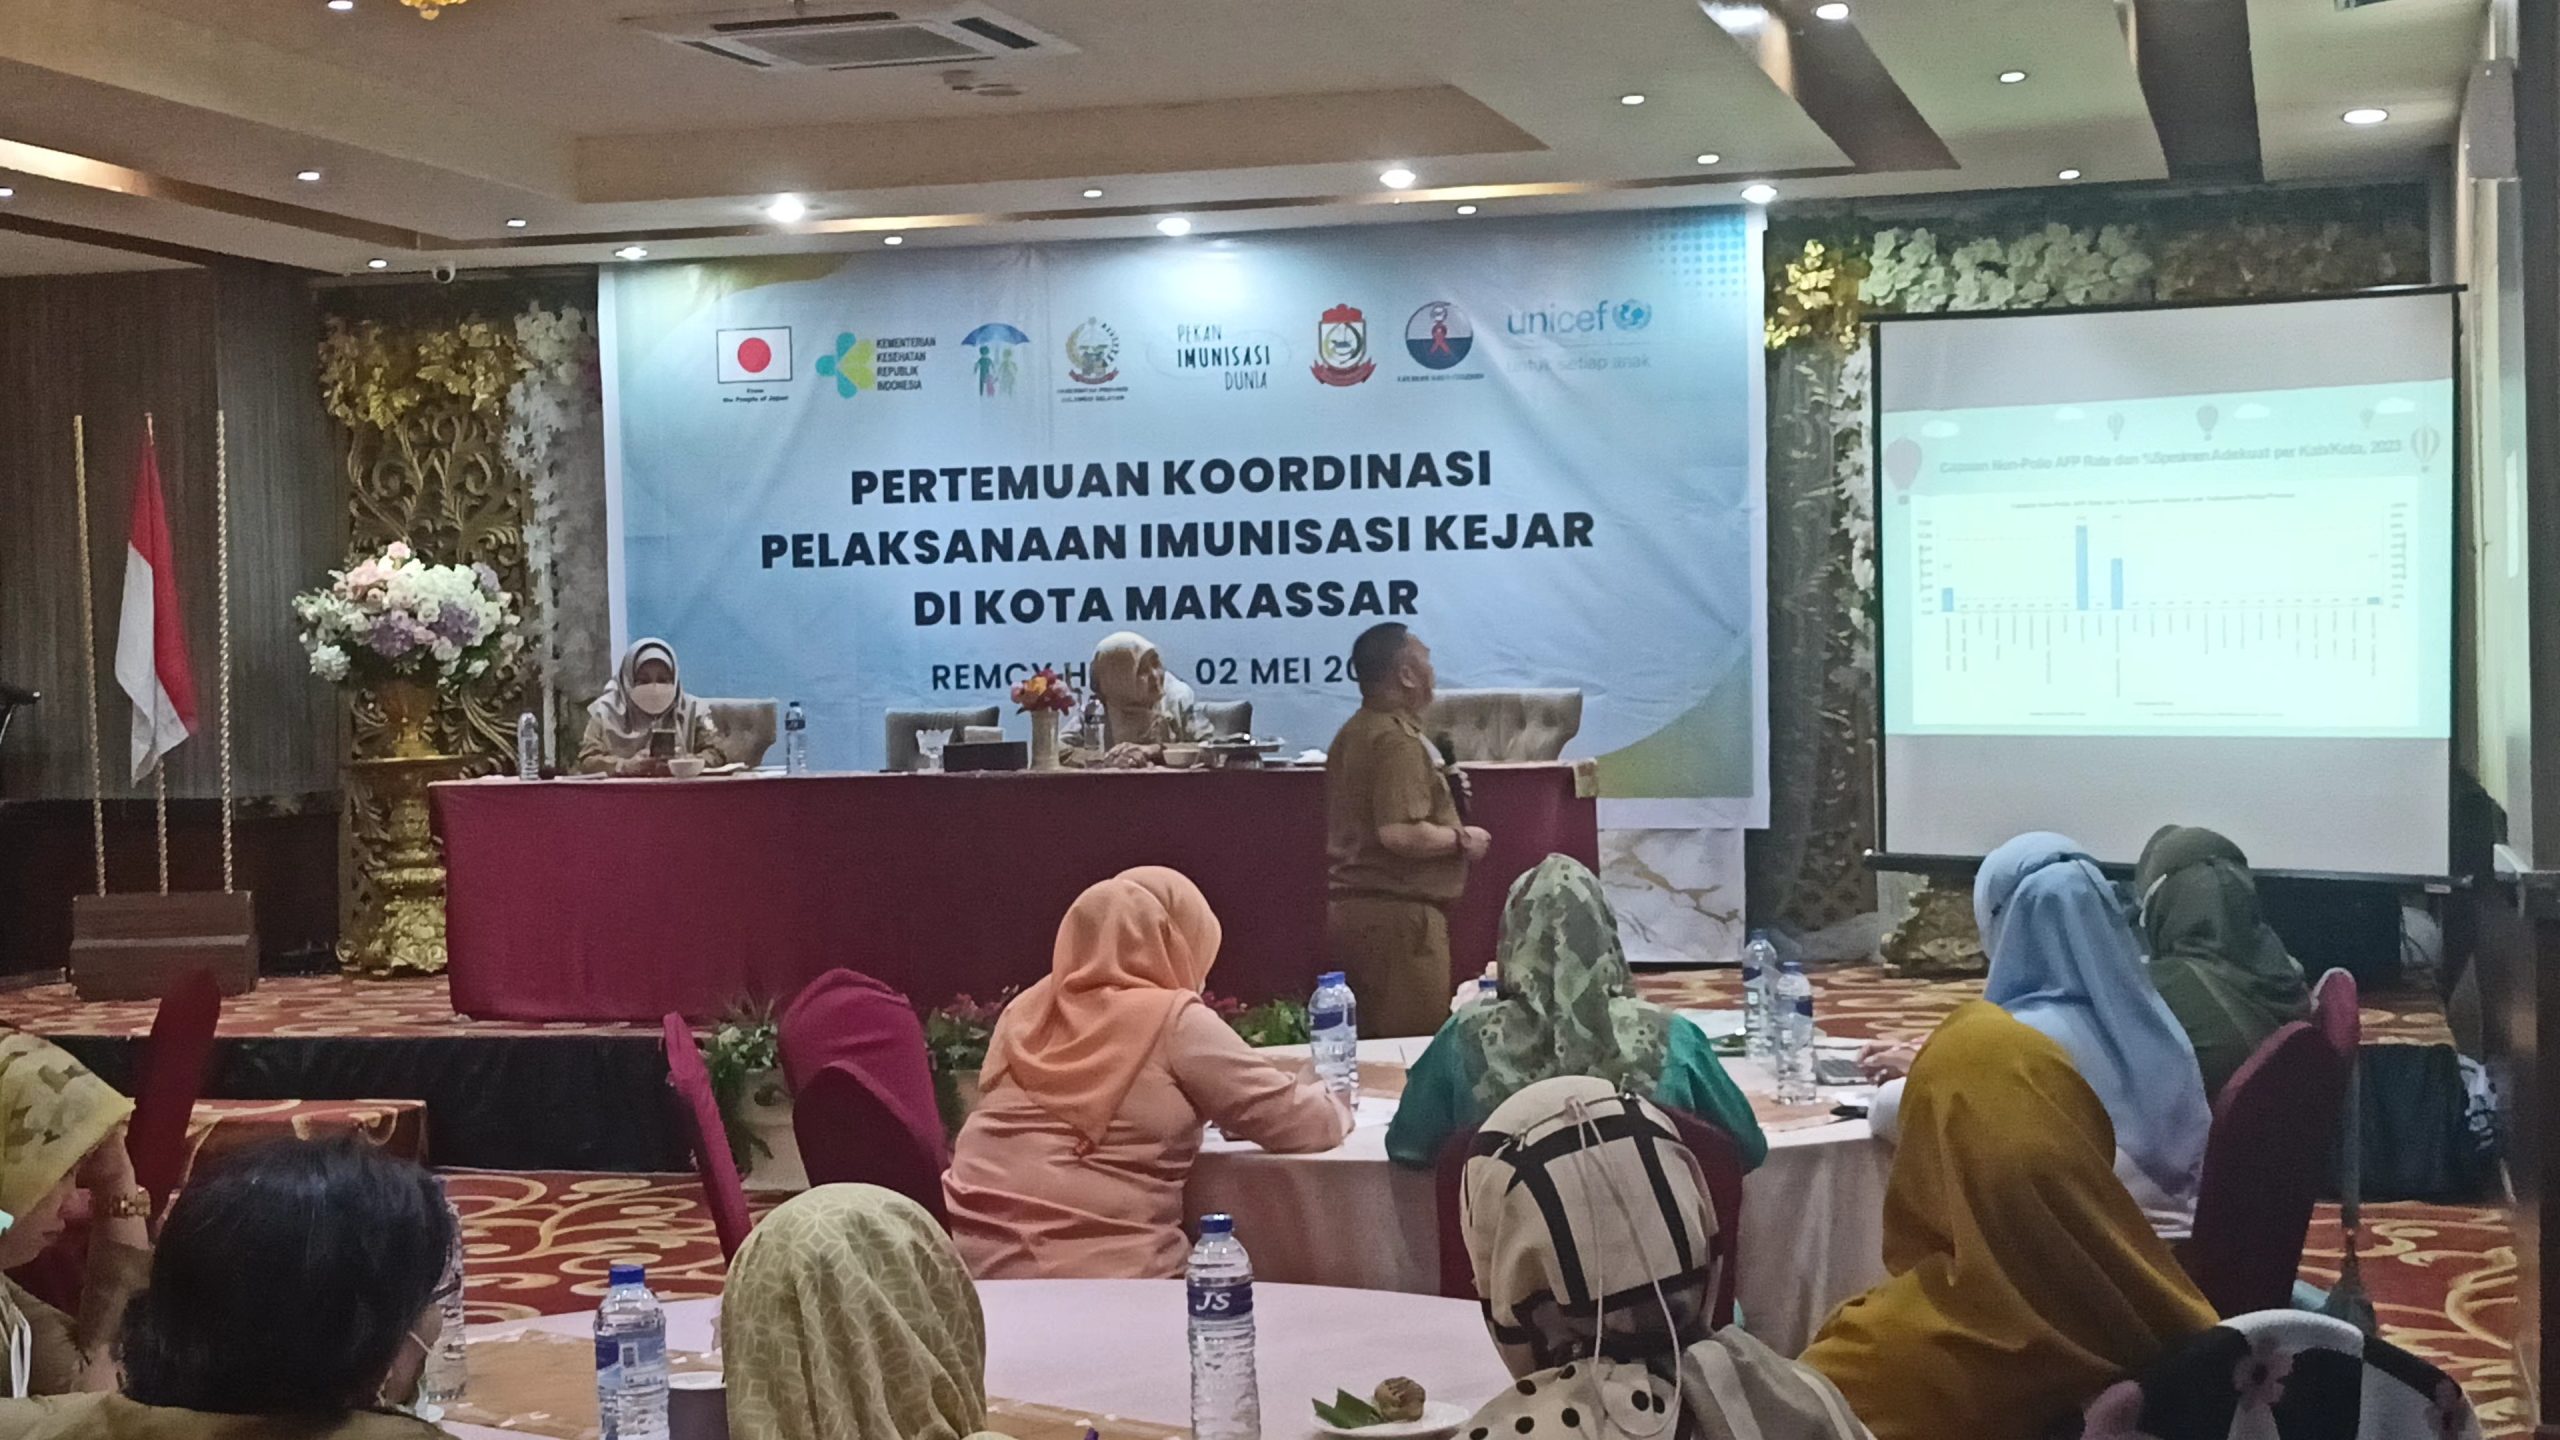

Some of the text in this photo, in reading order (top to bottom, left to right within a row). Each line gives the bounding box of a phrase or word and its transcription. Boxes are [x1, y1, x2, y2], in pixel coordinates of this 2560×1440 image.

[1507, 300, 1608, 335] unicef
[876, 337, 936, 349] KEMENTERIAN
[1178, 324, 1222, 342] PEKAN
[876, 351, 927, 362] KESEHATAN
[1178, 344, 1270, 369] IMUNISASI
[876, 365, 919, 377] REPUBLIK
[1224, 370, 1268, 391] DUNIA
[877, 379, 922, 391] INDONESIA
[852, 450, 1491, 505] PERTEMUAN KOORDINASI
[762, 511, 1594, 569] PELAKSANAAN IMUNISASI KEJAR
[915, 579, 1419, 627] DI KOTA MAKASSAR
[1195, 657, 1238, 685] 02
[1250, 656, 1311, 685] MEI
[1195, 1291, 1231, 1311] JS
